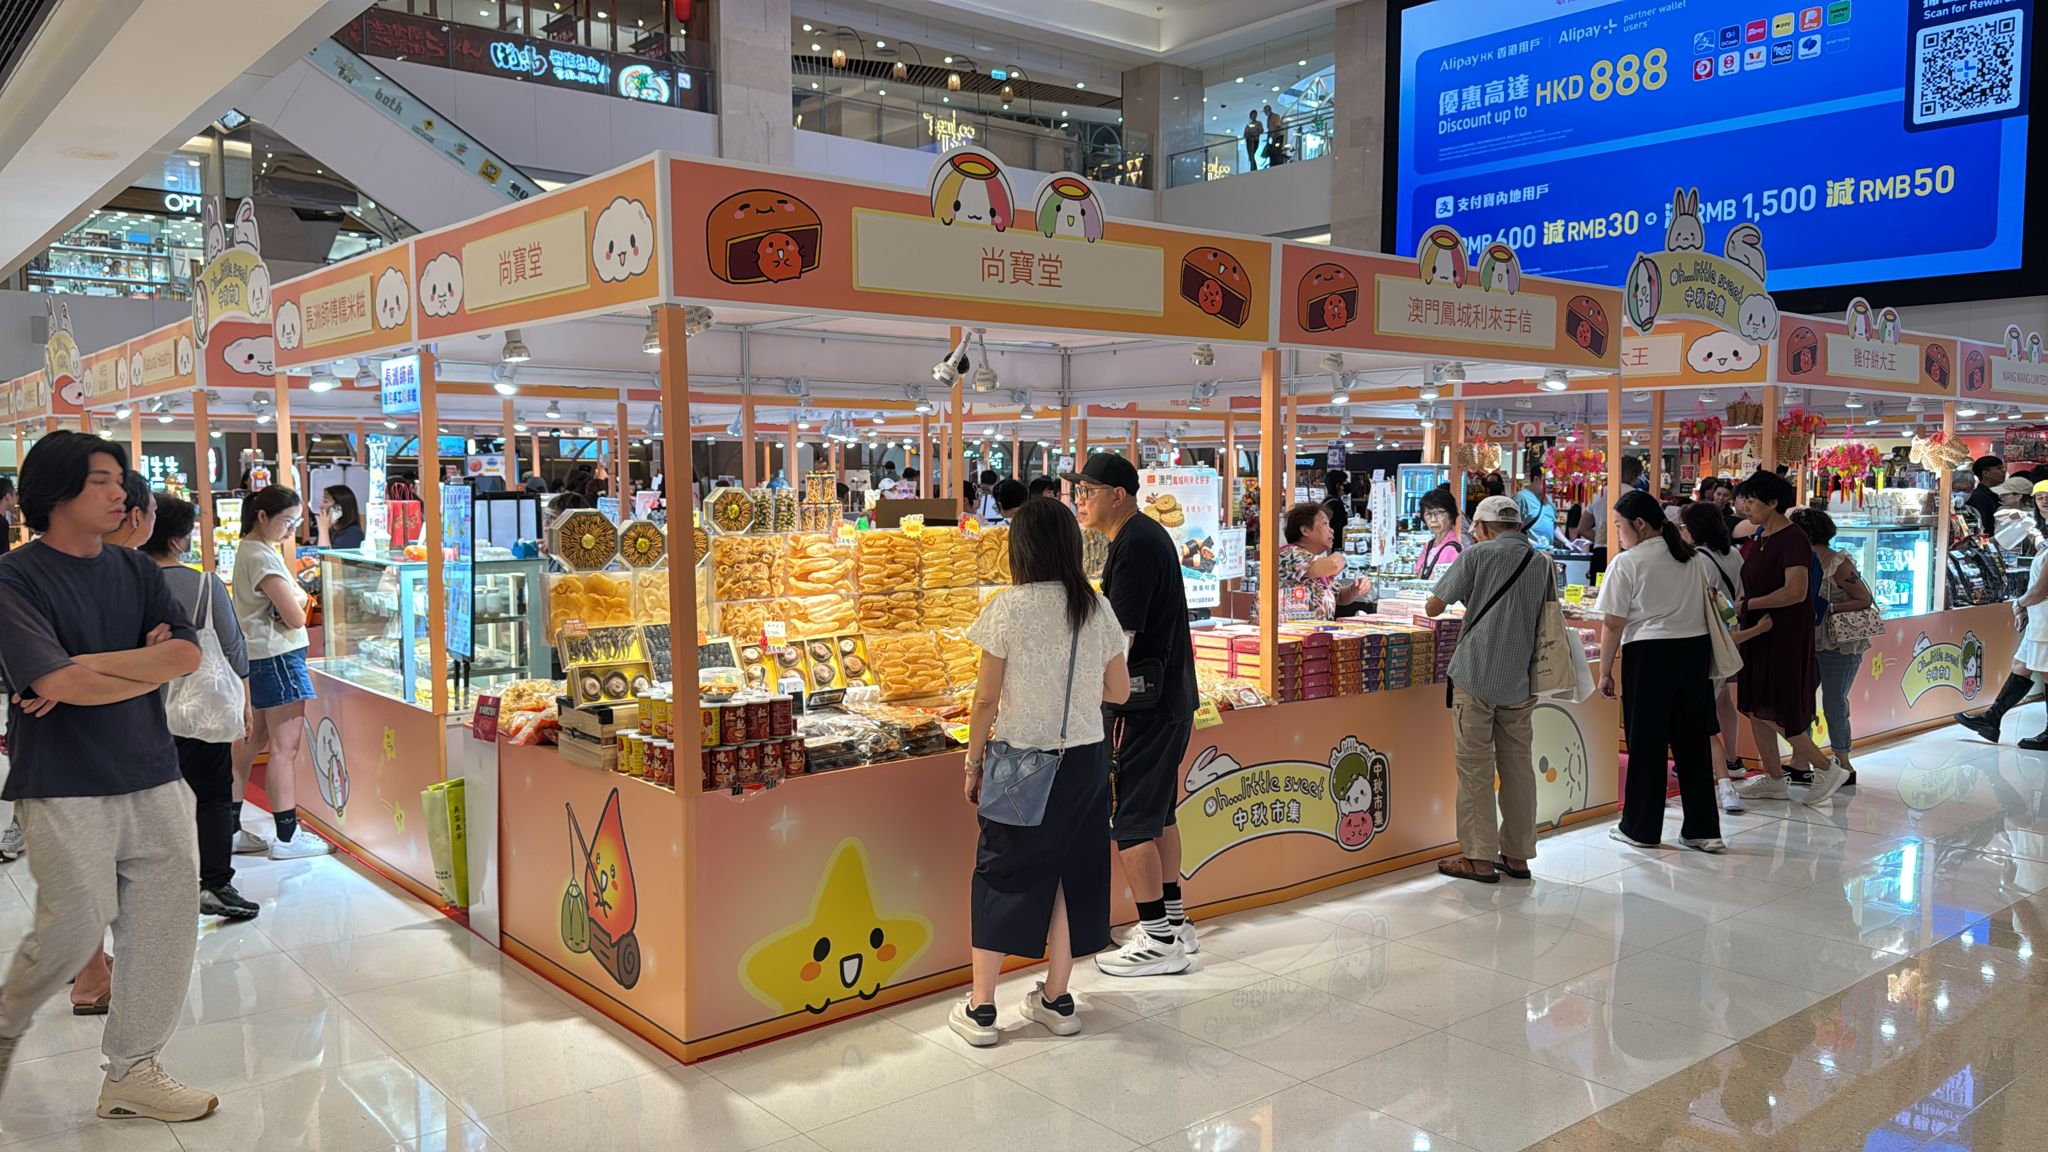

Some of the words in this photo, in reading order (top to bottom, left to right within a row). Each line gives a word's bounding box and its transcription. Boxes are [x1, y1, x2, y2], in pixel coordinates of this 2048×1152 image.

[1623, 8, 1657, 23] partner
[1659, 0, 1687, 14] wallet
[1623, 19, 1649, 32] users
[1924, 8, 1948, 19] Scan
[1951, 4, 1967, 13] for
[1535, 75, 1584, 106] HKD
[1589, 48, 1668, 101] 888
[1438, 74, 1530, 116] 優惠高達
[1438, 110, 1492, 135] Discount
[1495, 108, 1512, 125] up
[1514, 105, 1528, 119] to
[1742, 184, 1817, 223] 1,500
[499, 241, 543, 285] 尚寶堂
[981, 246, 1063, 288] 尚寶堂
[1408, 296, 1533, 333] 澳門鳳城利來手信
[1684, 287, 1727, 318] 中秋市集
[1283, 776, 1325, 800] sweet
[1372, 762, 1384, 827] 中秋市集
[1233, 799, 1301, 831] 中秋市集
